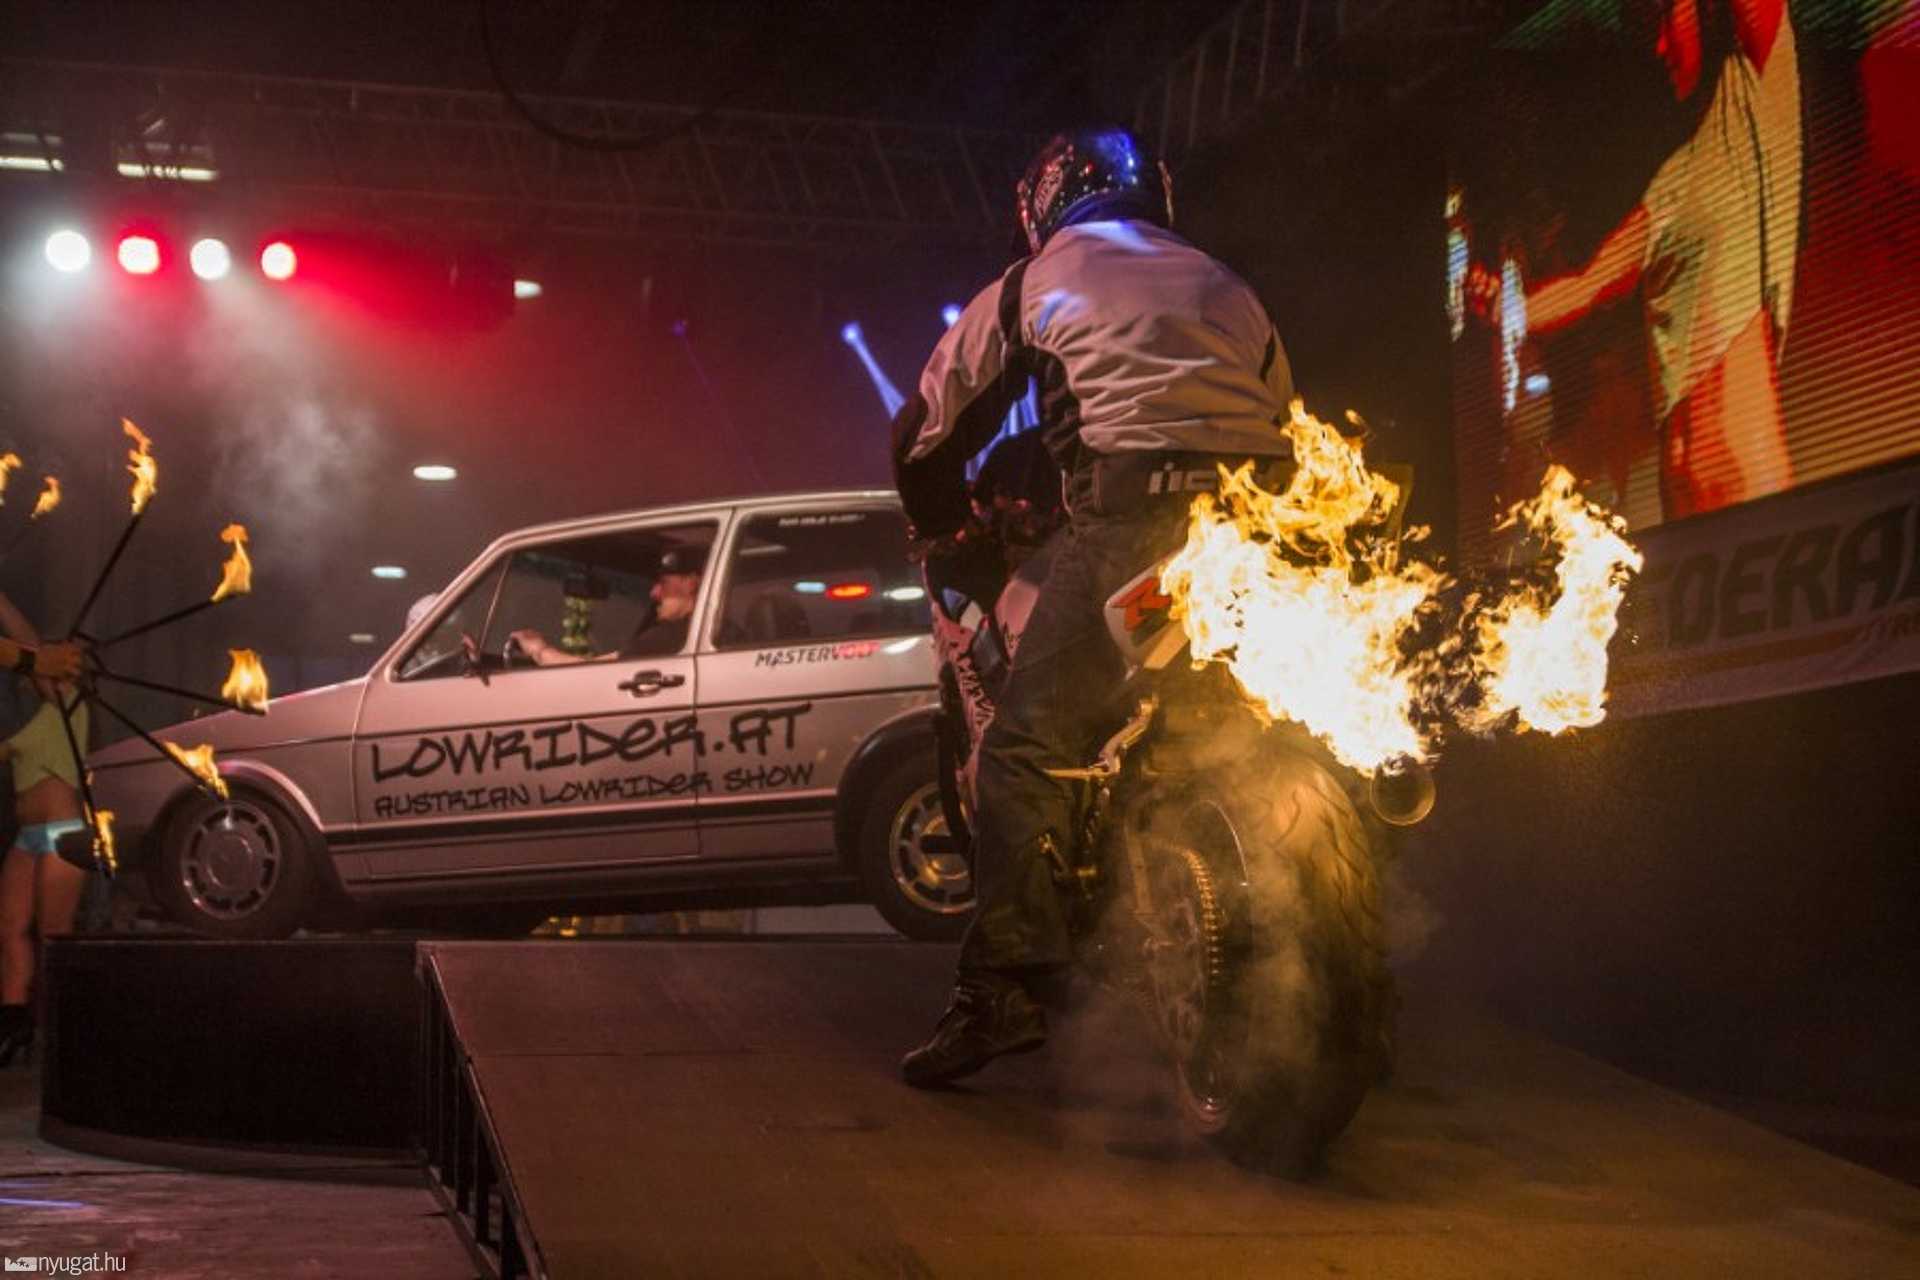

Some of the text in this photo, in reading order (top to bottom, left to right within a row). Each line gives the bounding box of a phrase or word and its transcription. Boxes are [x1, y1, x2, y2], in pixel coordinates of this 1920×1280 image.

[371, 702, 813, 783] LOWRIDER.AT
[374, 761, 815, 818] AUSTRIAN LOWRIDER SHOW
